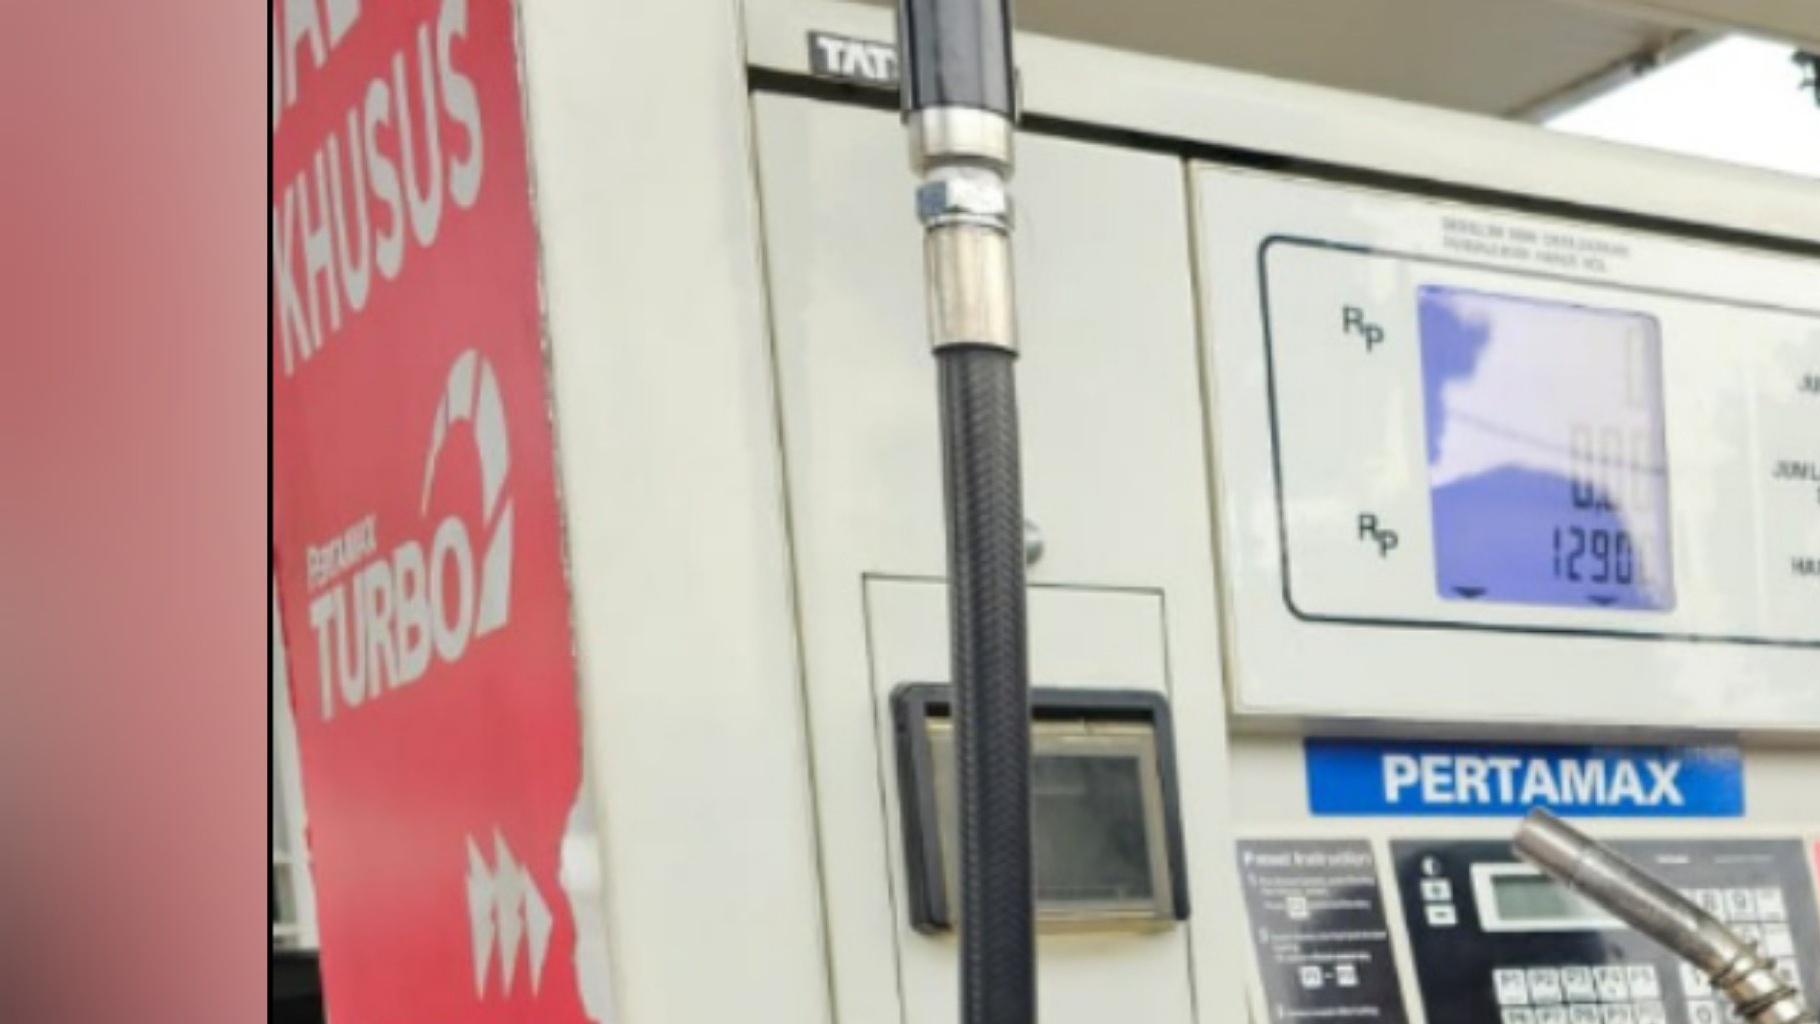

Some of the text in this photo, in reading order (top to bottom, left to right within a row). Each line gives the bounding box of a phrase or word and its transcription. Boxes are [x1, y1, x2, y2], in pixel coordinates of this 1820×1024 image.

[816, 36, 900, 82] TAT
[272, 0, 483, 377] KHUSUS
[1342, 305, 1384, 353] Rp
[306, 515, 377, 590] PERTAMAX
[1359, 512, 1399, 558] Rp
[309, 516, 475, 718] TURBO
[1383, 753, 1684, 806] PERTAMAX
